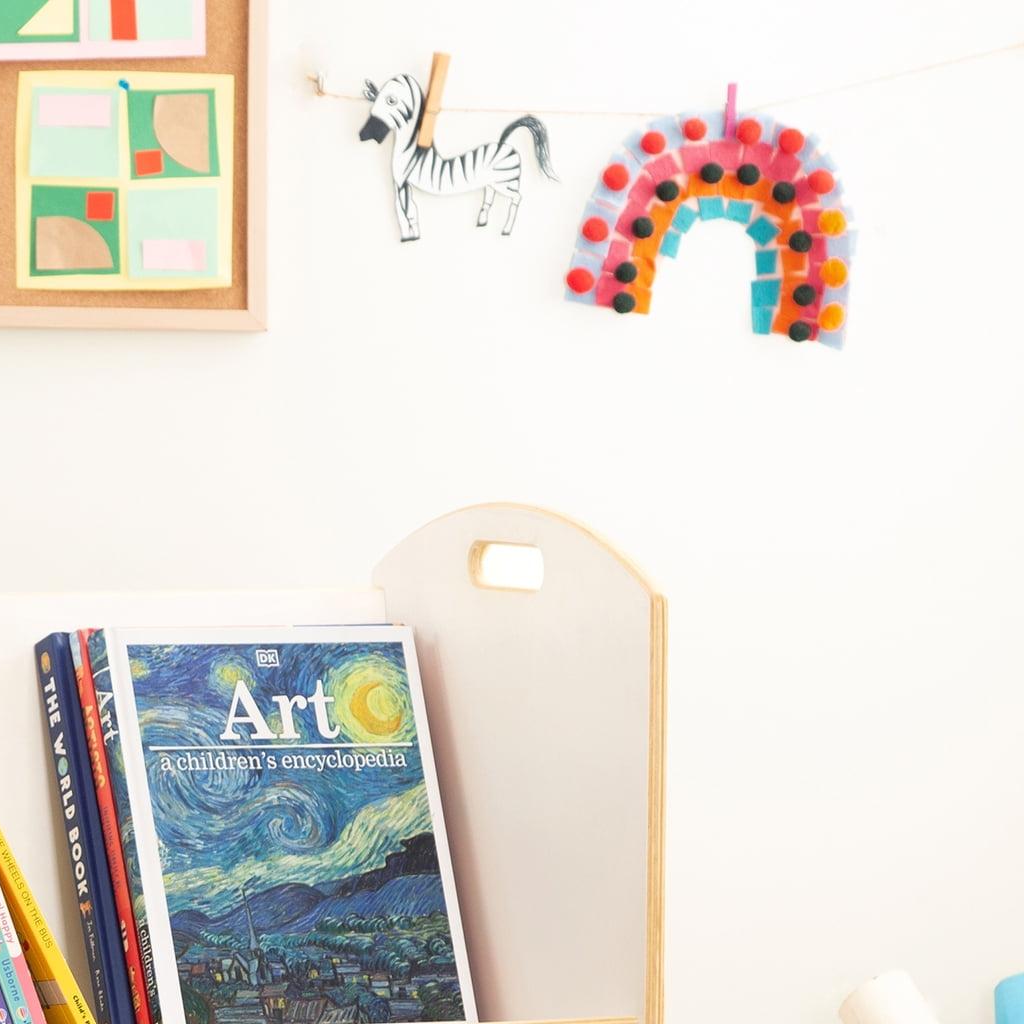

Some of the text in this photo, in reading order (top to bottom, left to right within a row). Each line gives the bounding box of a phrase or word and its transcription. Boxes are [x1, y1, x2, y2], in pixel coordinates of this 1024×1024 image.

[95, 687, 121, 746] Art
[220, 680, 341, 740] Art
[42, 677, 90, 897] THE WORLD BOOK
[161, 749, 406, 771] a children's encyclopedia
[1, 850, 26, 890] WHEELS
[20, 891, 33, 907] ON
[28, 907, 43, 927] THE
[38, 928, 54, 949] BUS
[1, 958, 22, 1002] Usborne
[138, 928, 158, 997] children's
[72, 994, 87, 1019] Child's
